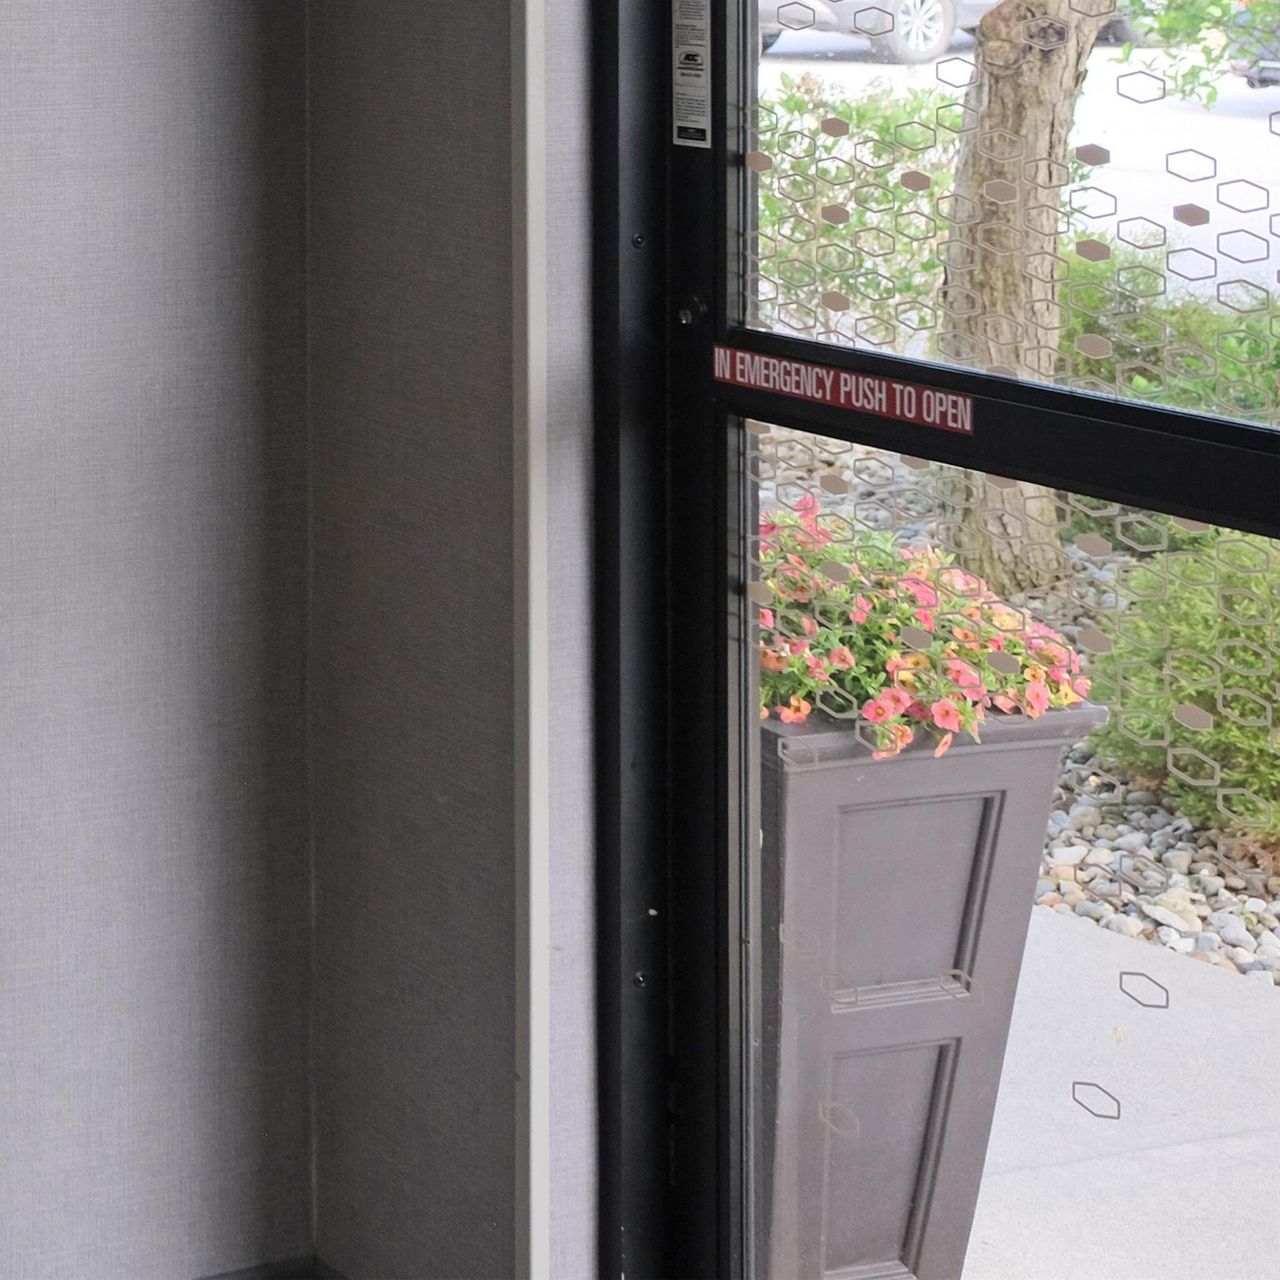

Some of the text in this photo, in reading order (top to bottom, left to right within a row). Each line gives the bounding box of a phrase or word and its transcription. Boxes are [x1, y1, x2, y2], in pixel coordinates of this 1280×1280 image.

[713, 346, 972, 431] IN EMERGENCY PUSH TO OPEN
